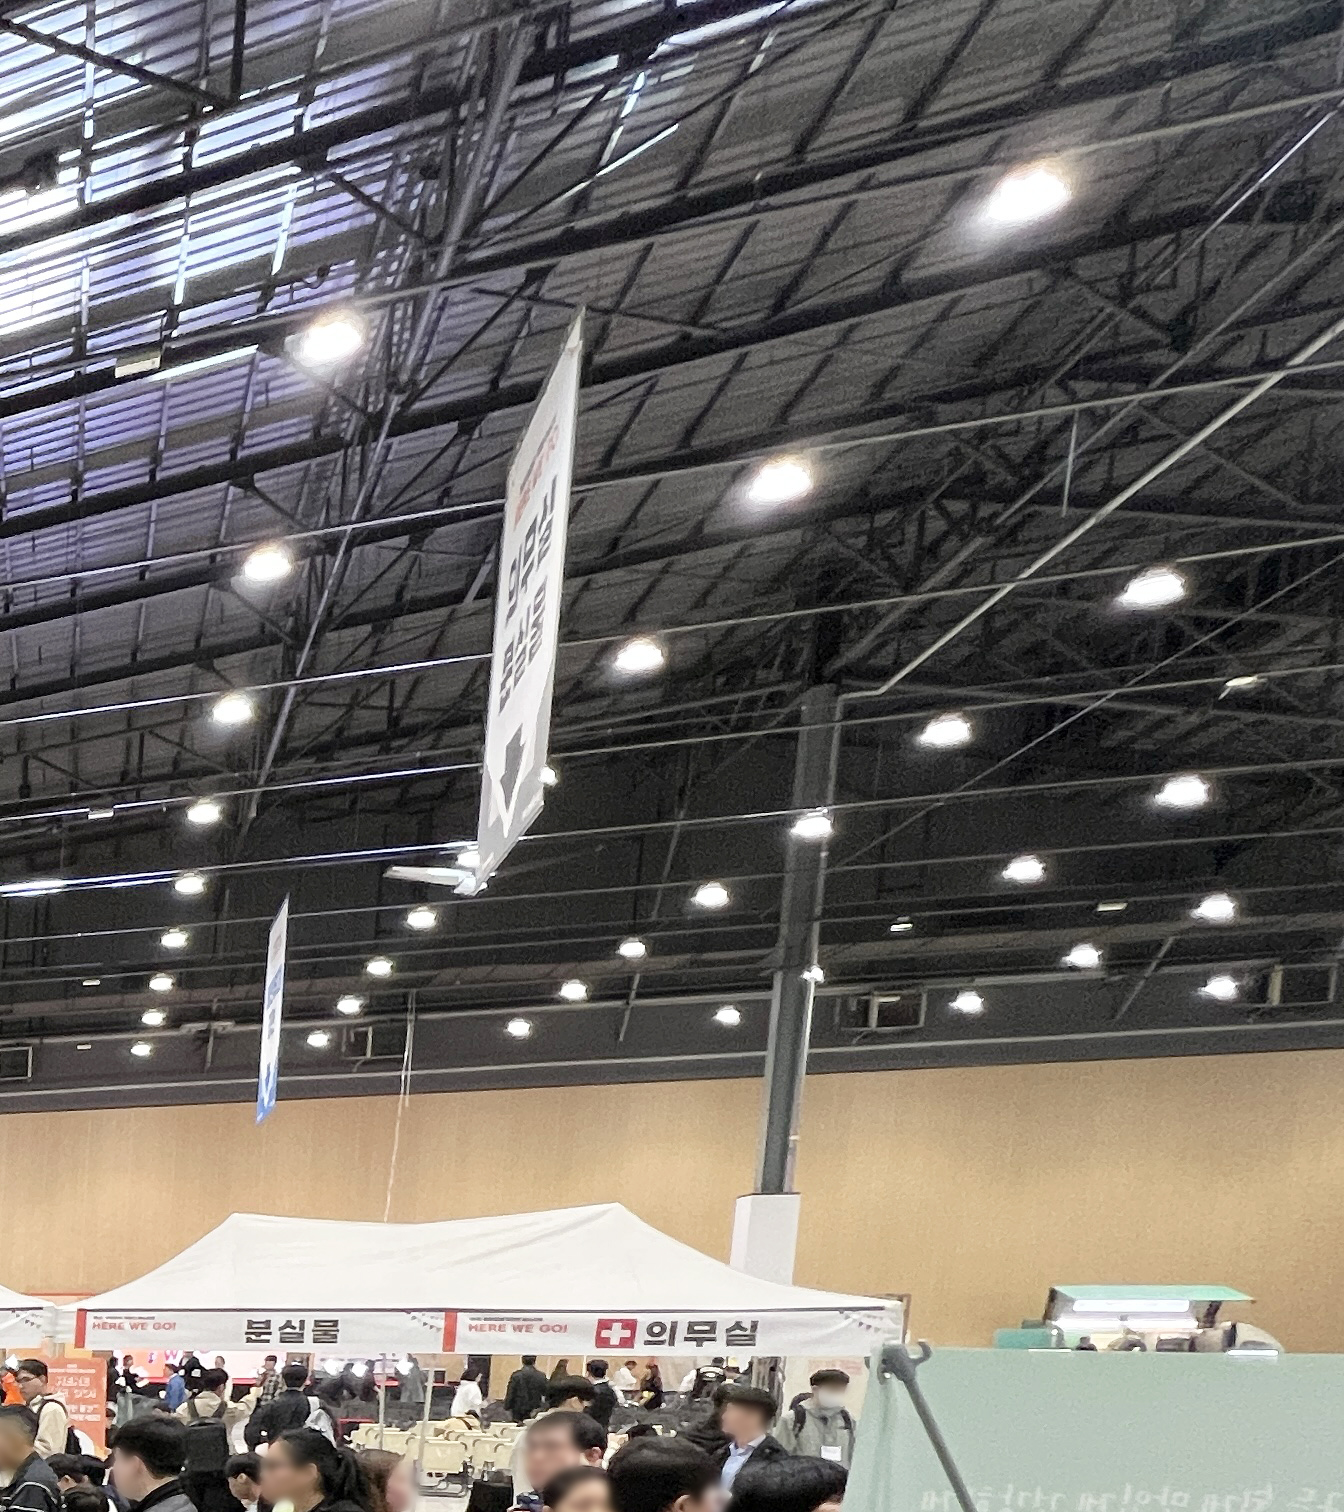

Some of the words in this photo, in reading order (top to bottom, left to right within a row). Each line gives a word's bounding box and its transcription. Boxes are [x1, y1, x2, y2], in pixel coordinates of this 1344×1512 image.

[92, 1321, 125, 1331] HERE
[129, 1321, 149, 1331] WE
[153, 1321, 176, 1331] GO!
[245, 1319, 340, 1344] 분실물
[468, 1323, 506, 1333] HERE
[512, 1323, 534, 1333] WE
[539, 1323, 568, 1334] GO!
[644, 1320, 759, 1347] 의무실
